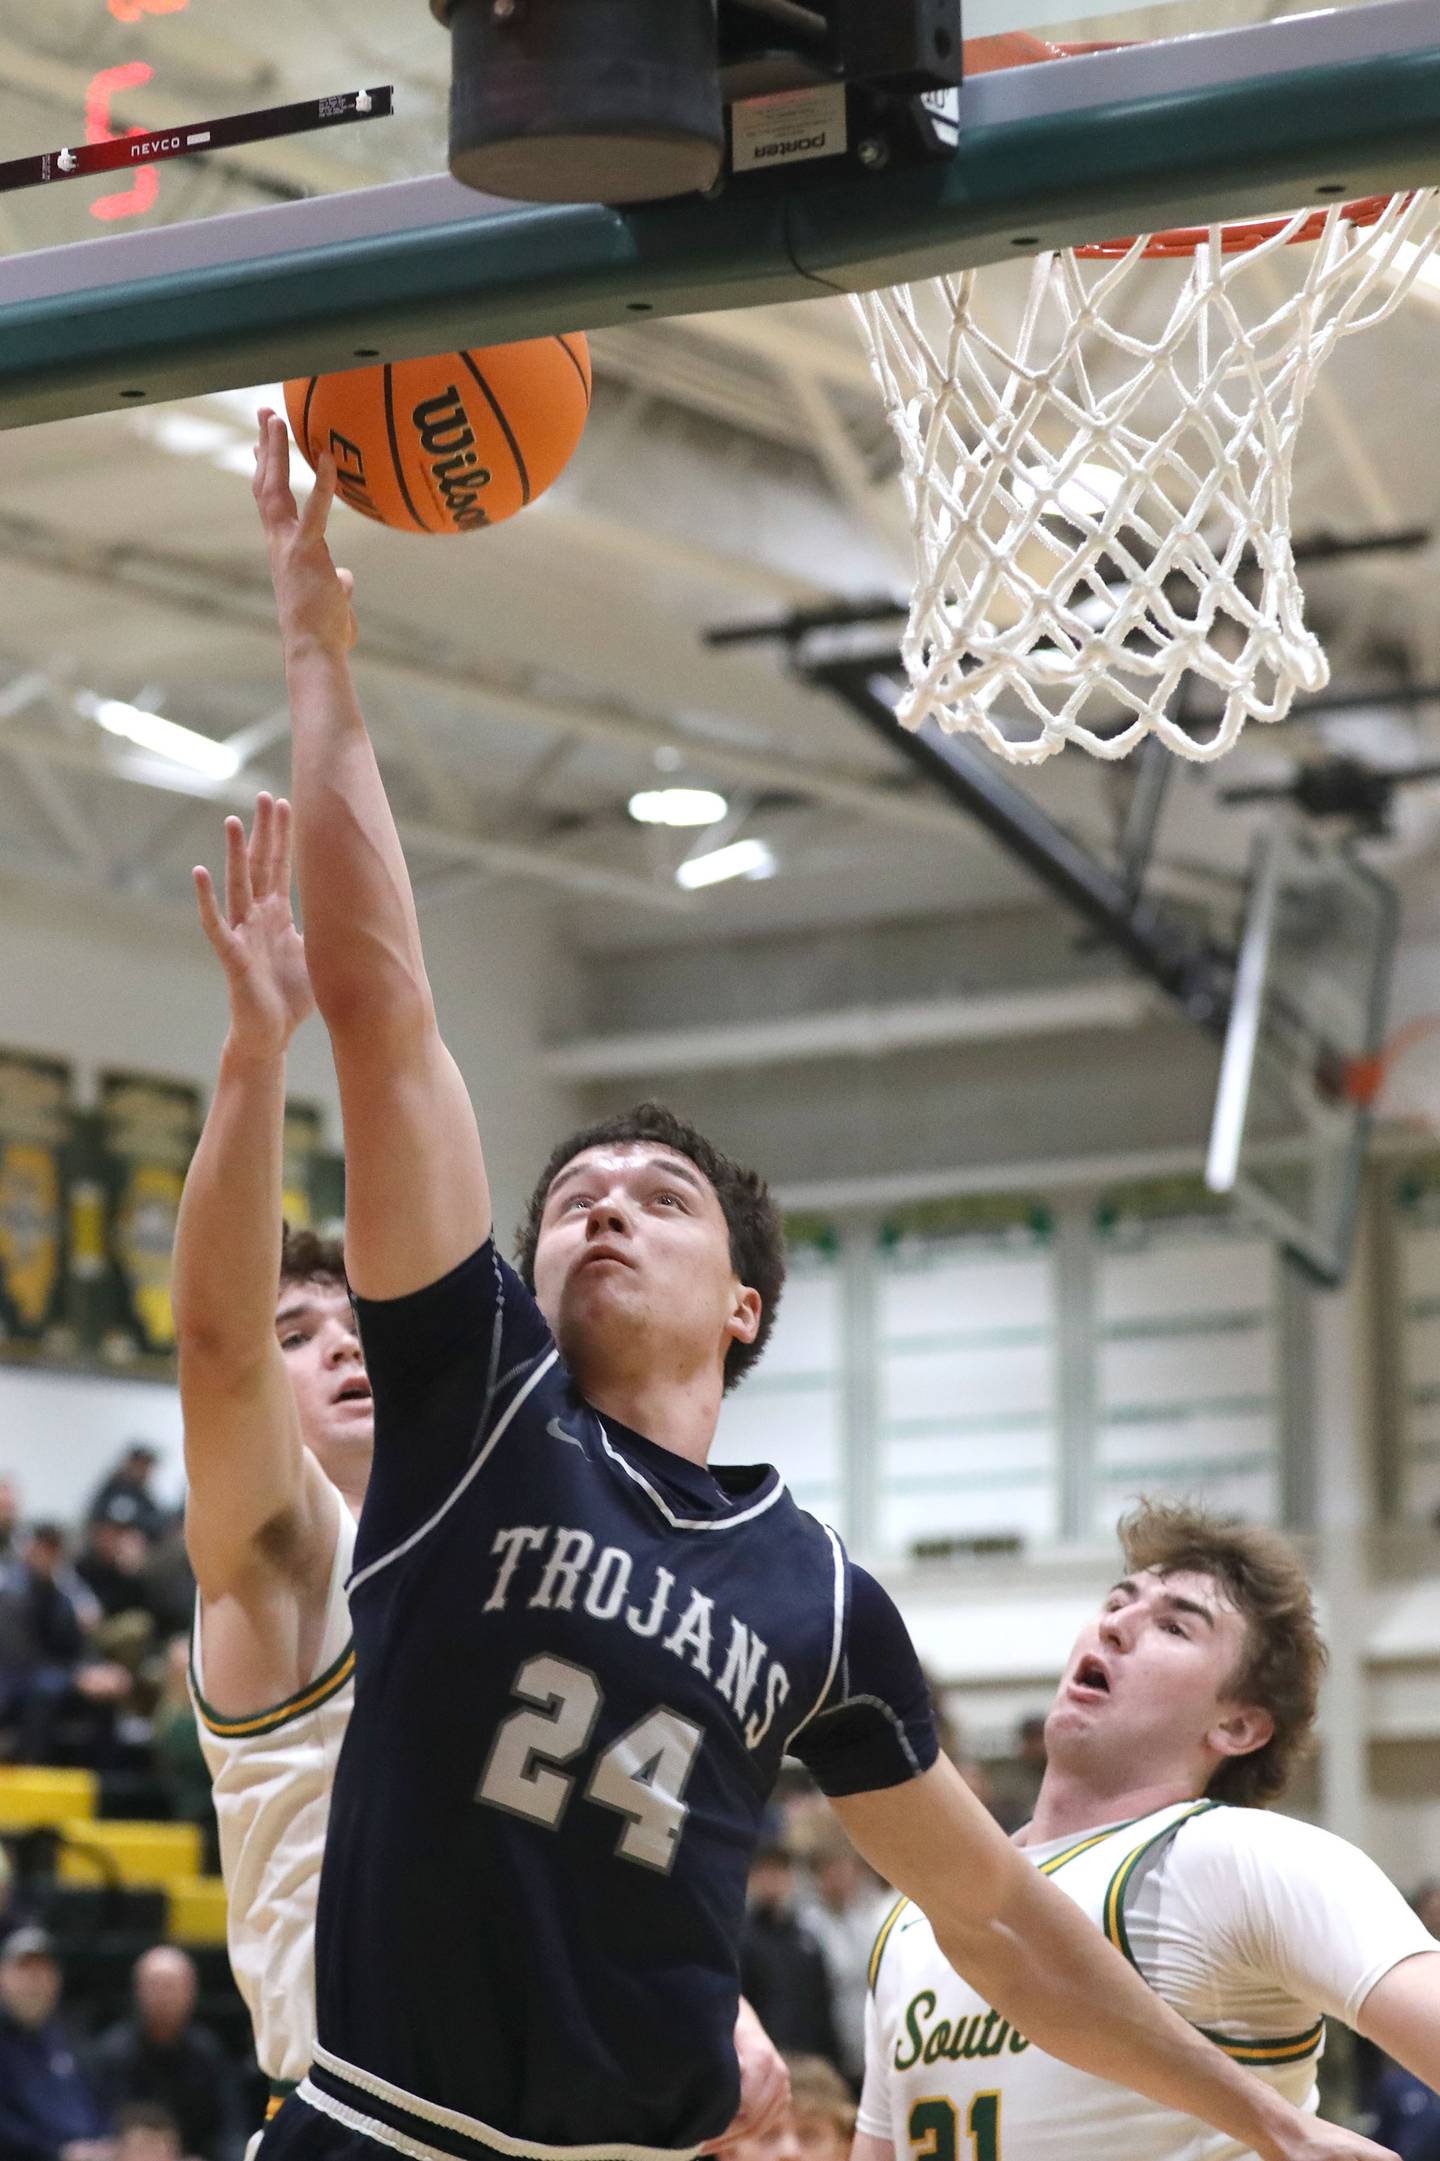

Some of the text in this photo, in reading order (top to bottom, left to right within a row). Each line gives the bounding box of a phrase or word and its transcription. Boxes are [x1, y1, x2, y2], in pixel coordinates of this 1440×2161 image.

[131, 136, 181, 156] NEVCO
[481, 1525, 790, 1750] TROJANS
[474, 1651, 706, 1876] 24
